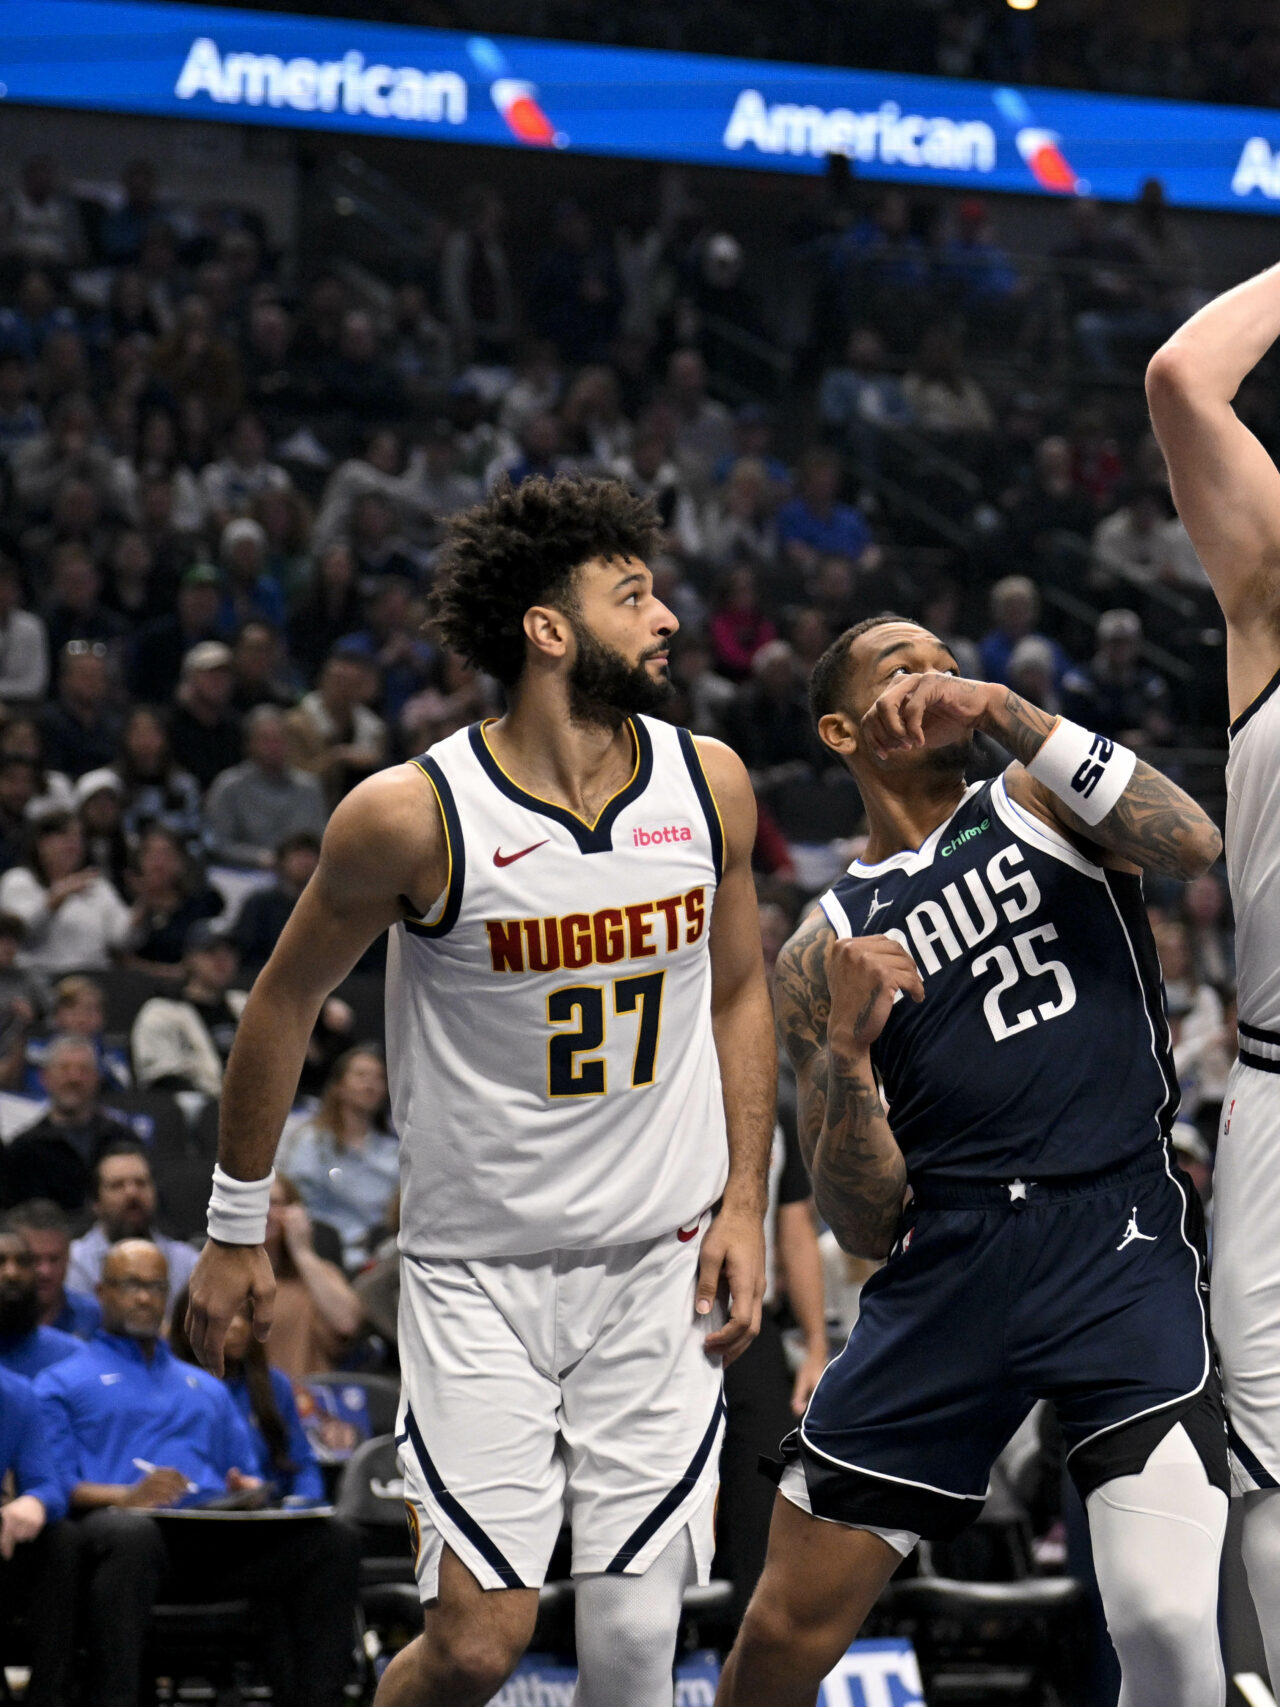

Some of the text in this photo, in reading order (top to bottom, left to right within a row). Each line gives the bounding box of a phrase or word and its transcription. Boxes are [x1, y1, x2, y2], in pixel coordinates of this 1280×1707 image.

[174, 37, 467, 124] American
[724, 89, 995, 173] American
[633, 825, 692, 847] ibotta
[941, 817, 991, 857] chime
[485, 886, 706, 972] NUGGETS
[971, 922, 1076, 1042] 25
[545, 969, 668, 1098] 27
